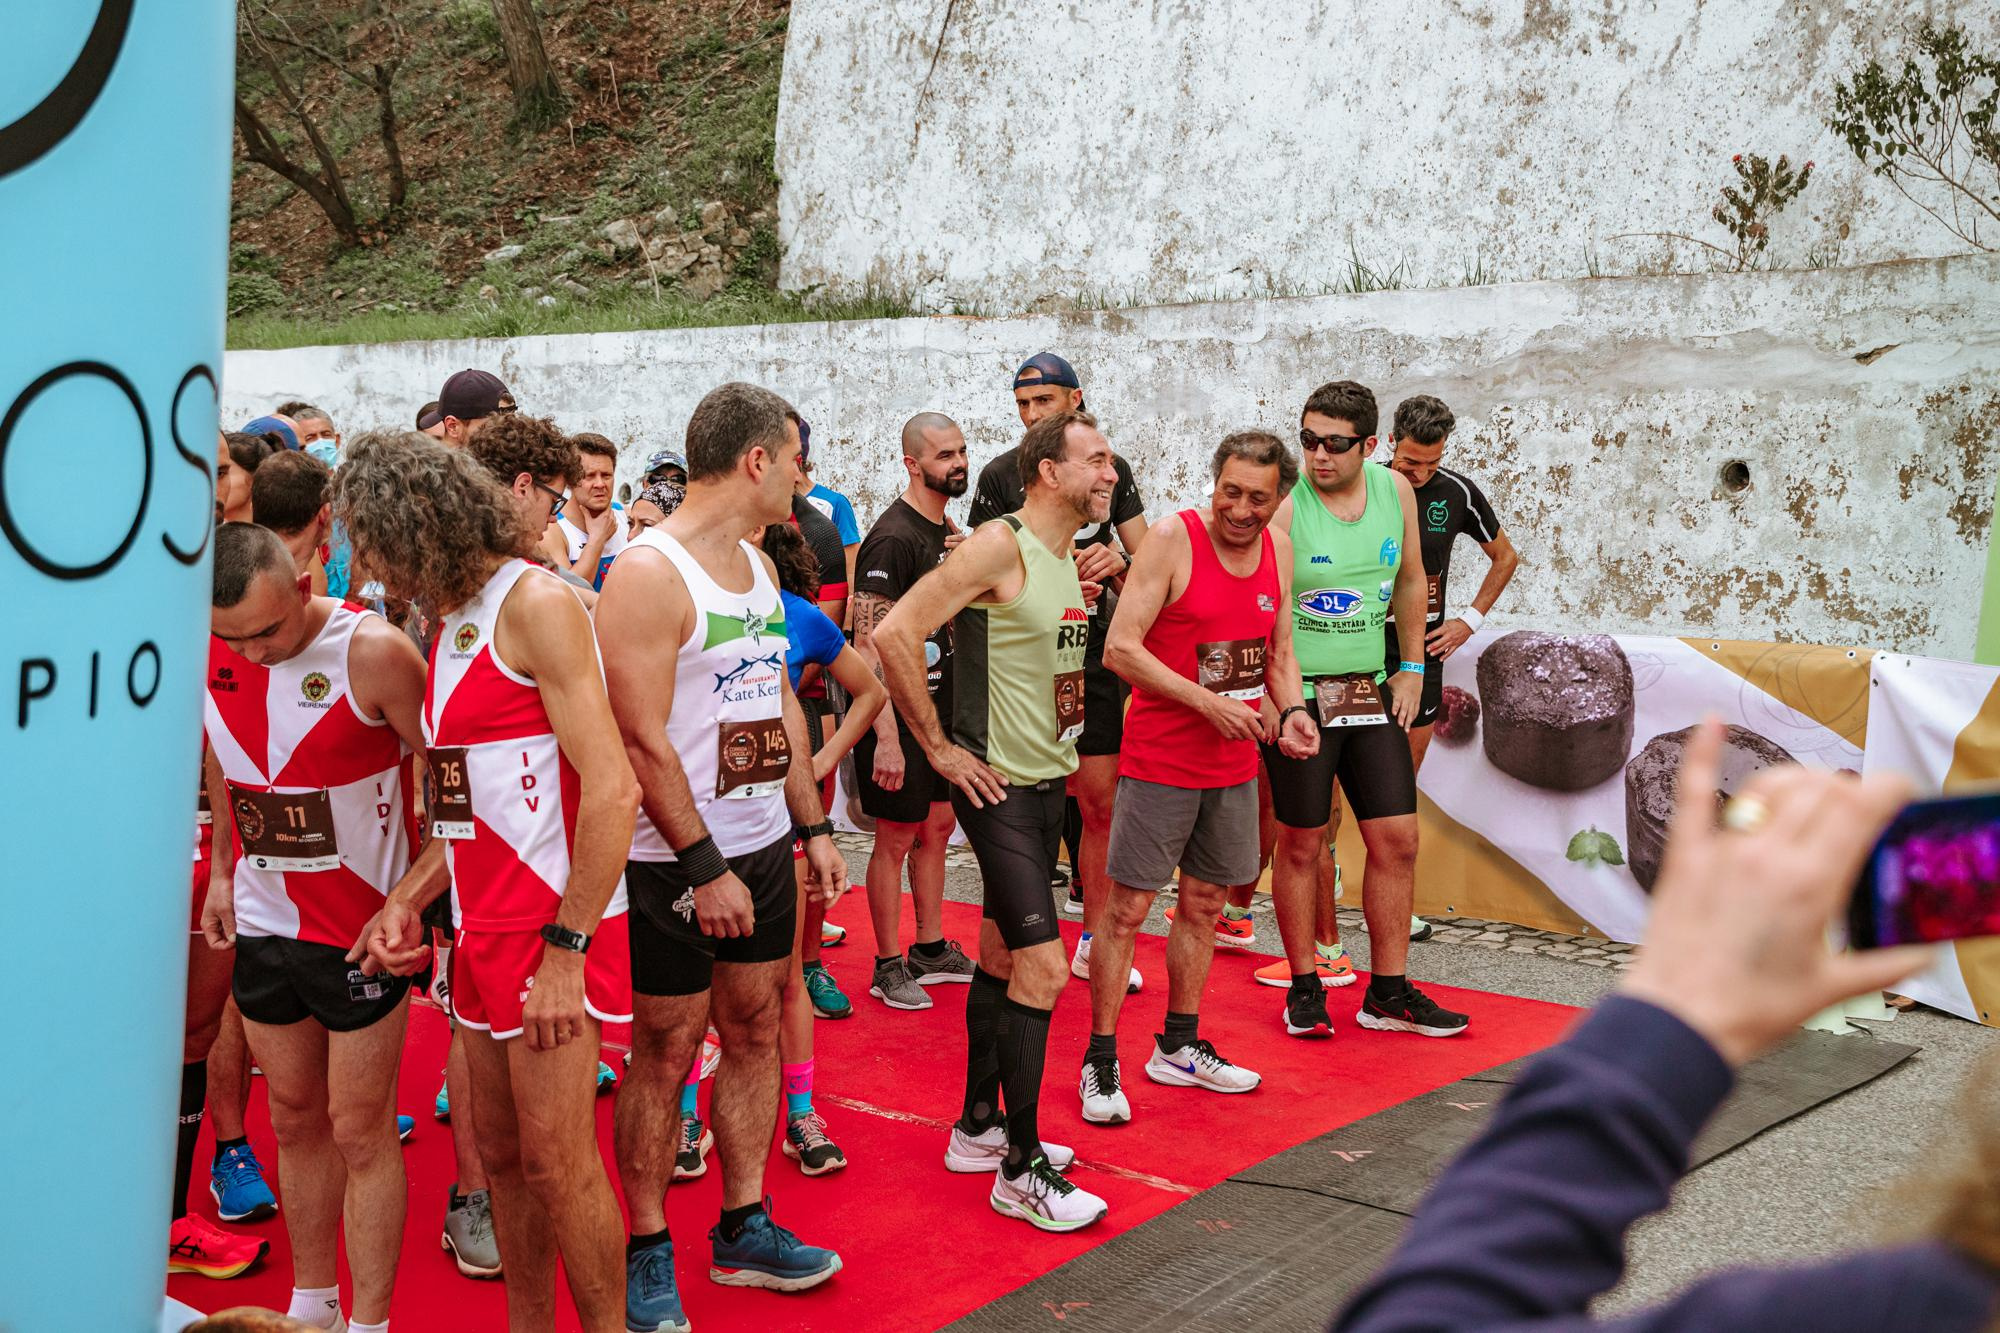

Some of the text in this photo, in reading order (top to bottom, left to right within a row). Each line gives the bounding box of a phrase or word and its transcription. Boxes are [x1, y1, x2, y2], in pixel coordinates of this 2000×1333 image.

[1320, 595, 1345, 611] DL
[1241, 647, 1262, 666] 112
[18, 640, 161, 730] PIO
[1352, 680, 1372, 694] 25
[722, 687, 754, 704] Kate
[763, 729, 787, 752] 145
[441, 761, 461, 787] 26
[284, 806, 307, 828] 11
[275, 833, 298, 842] 10km
